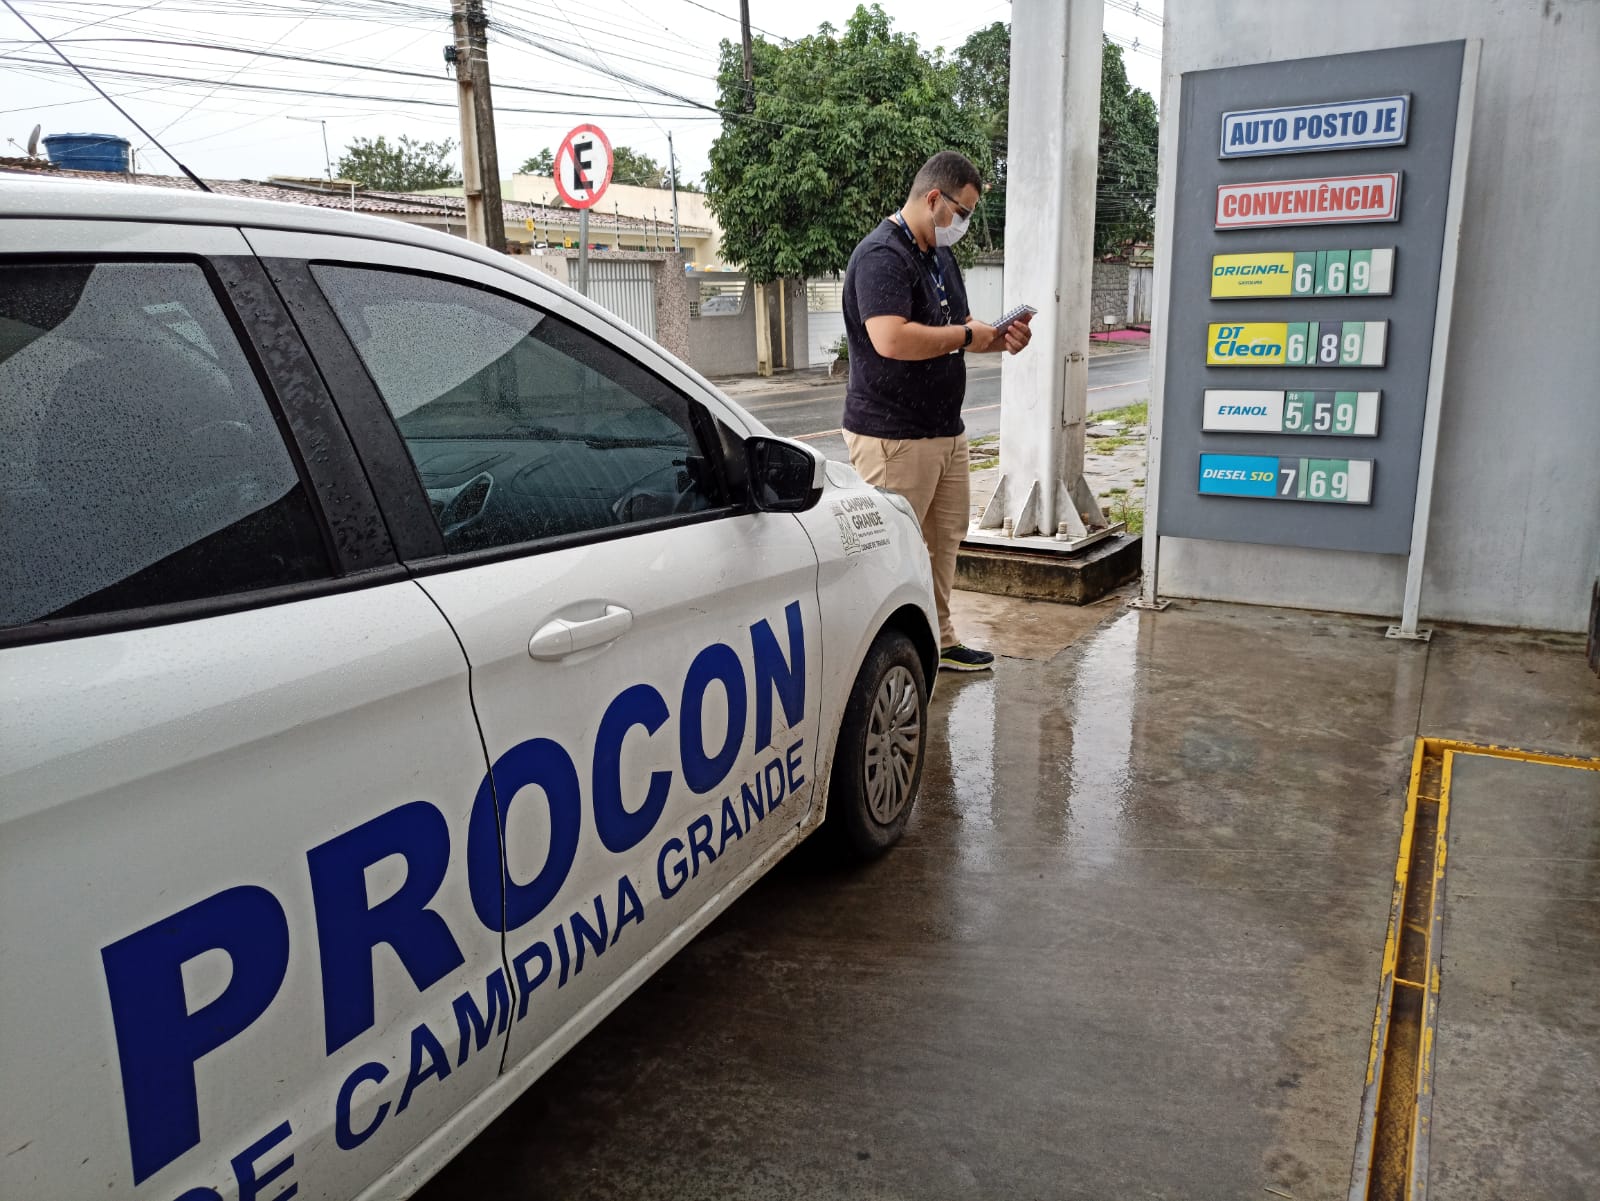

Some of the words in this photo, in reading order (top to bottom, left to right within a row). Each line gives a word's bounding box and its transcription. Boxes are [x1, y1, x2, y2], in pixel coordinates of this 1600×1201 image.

[1230, 117, 1288, 146] AUTO
[1292, 110, 1368, 141] POSTO
[1372, 107, 1397, 134] JE
[574, 141, 593, 190] E
[1222, 184, 1385, 218] CONVENIÊNCIA
[1213, 264, 1289, 276] ORIGINAL
[1295, 261, 1370, 294] 6,69
[1214, 340, 1282, 356] Clean
[1287, 333, 1361, 364] 6,89
[1217, 326, 1245, 339] DT
[1217, 405, 1268, 416] ETANOL
[1285, 402, 1354, 431] 5,59
[1203, 468, 1247, 480] DIESEL
[1250, 471, 1274, 482] S10
[840, 495, 877, 513] CAMPINA
[851, 511, 884, 530] GRANDE
[101, 600, 805, 1186] PROCON
[173, 1120, 298, 1201] E
[335, 874, 645, 1151] CAMPINA
[657, 738, 804, 900] GRANDE
